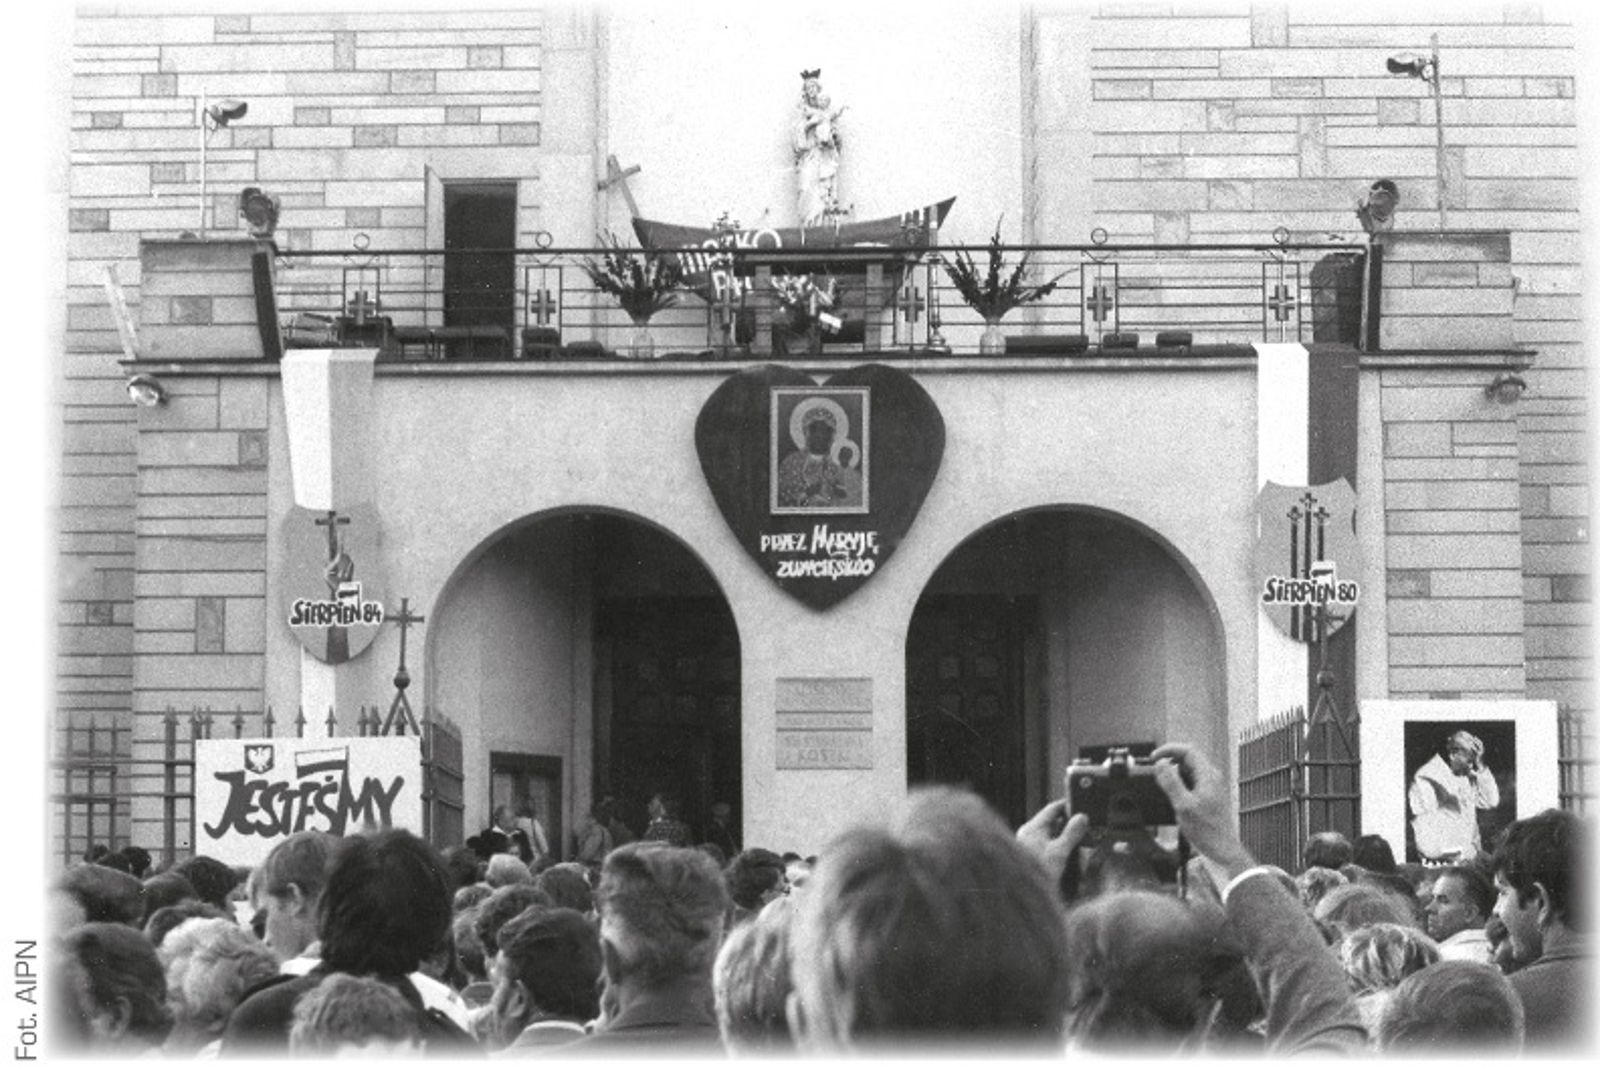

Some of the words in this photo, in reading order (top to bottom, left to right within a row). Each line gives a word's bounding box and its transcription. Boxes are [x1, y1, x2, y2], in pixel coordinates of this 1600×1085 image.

[760, 532, 807, 552] PRZEZ
[1338, 583, 1357, 602] 80
[363, 603, 382, 623] 84
[203, 770, 405, 839] JESTEŚMY
